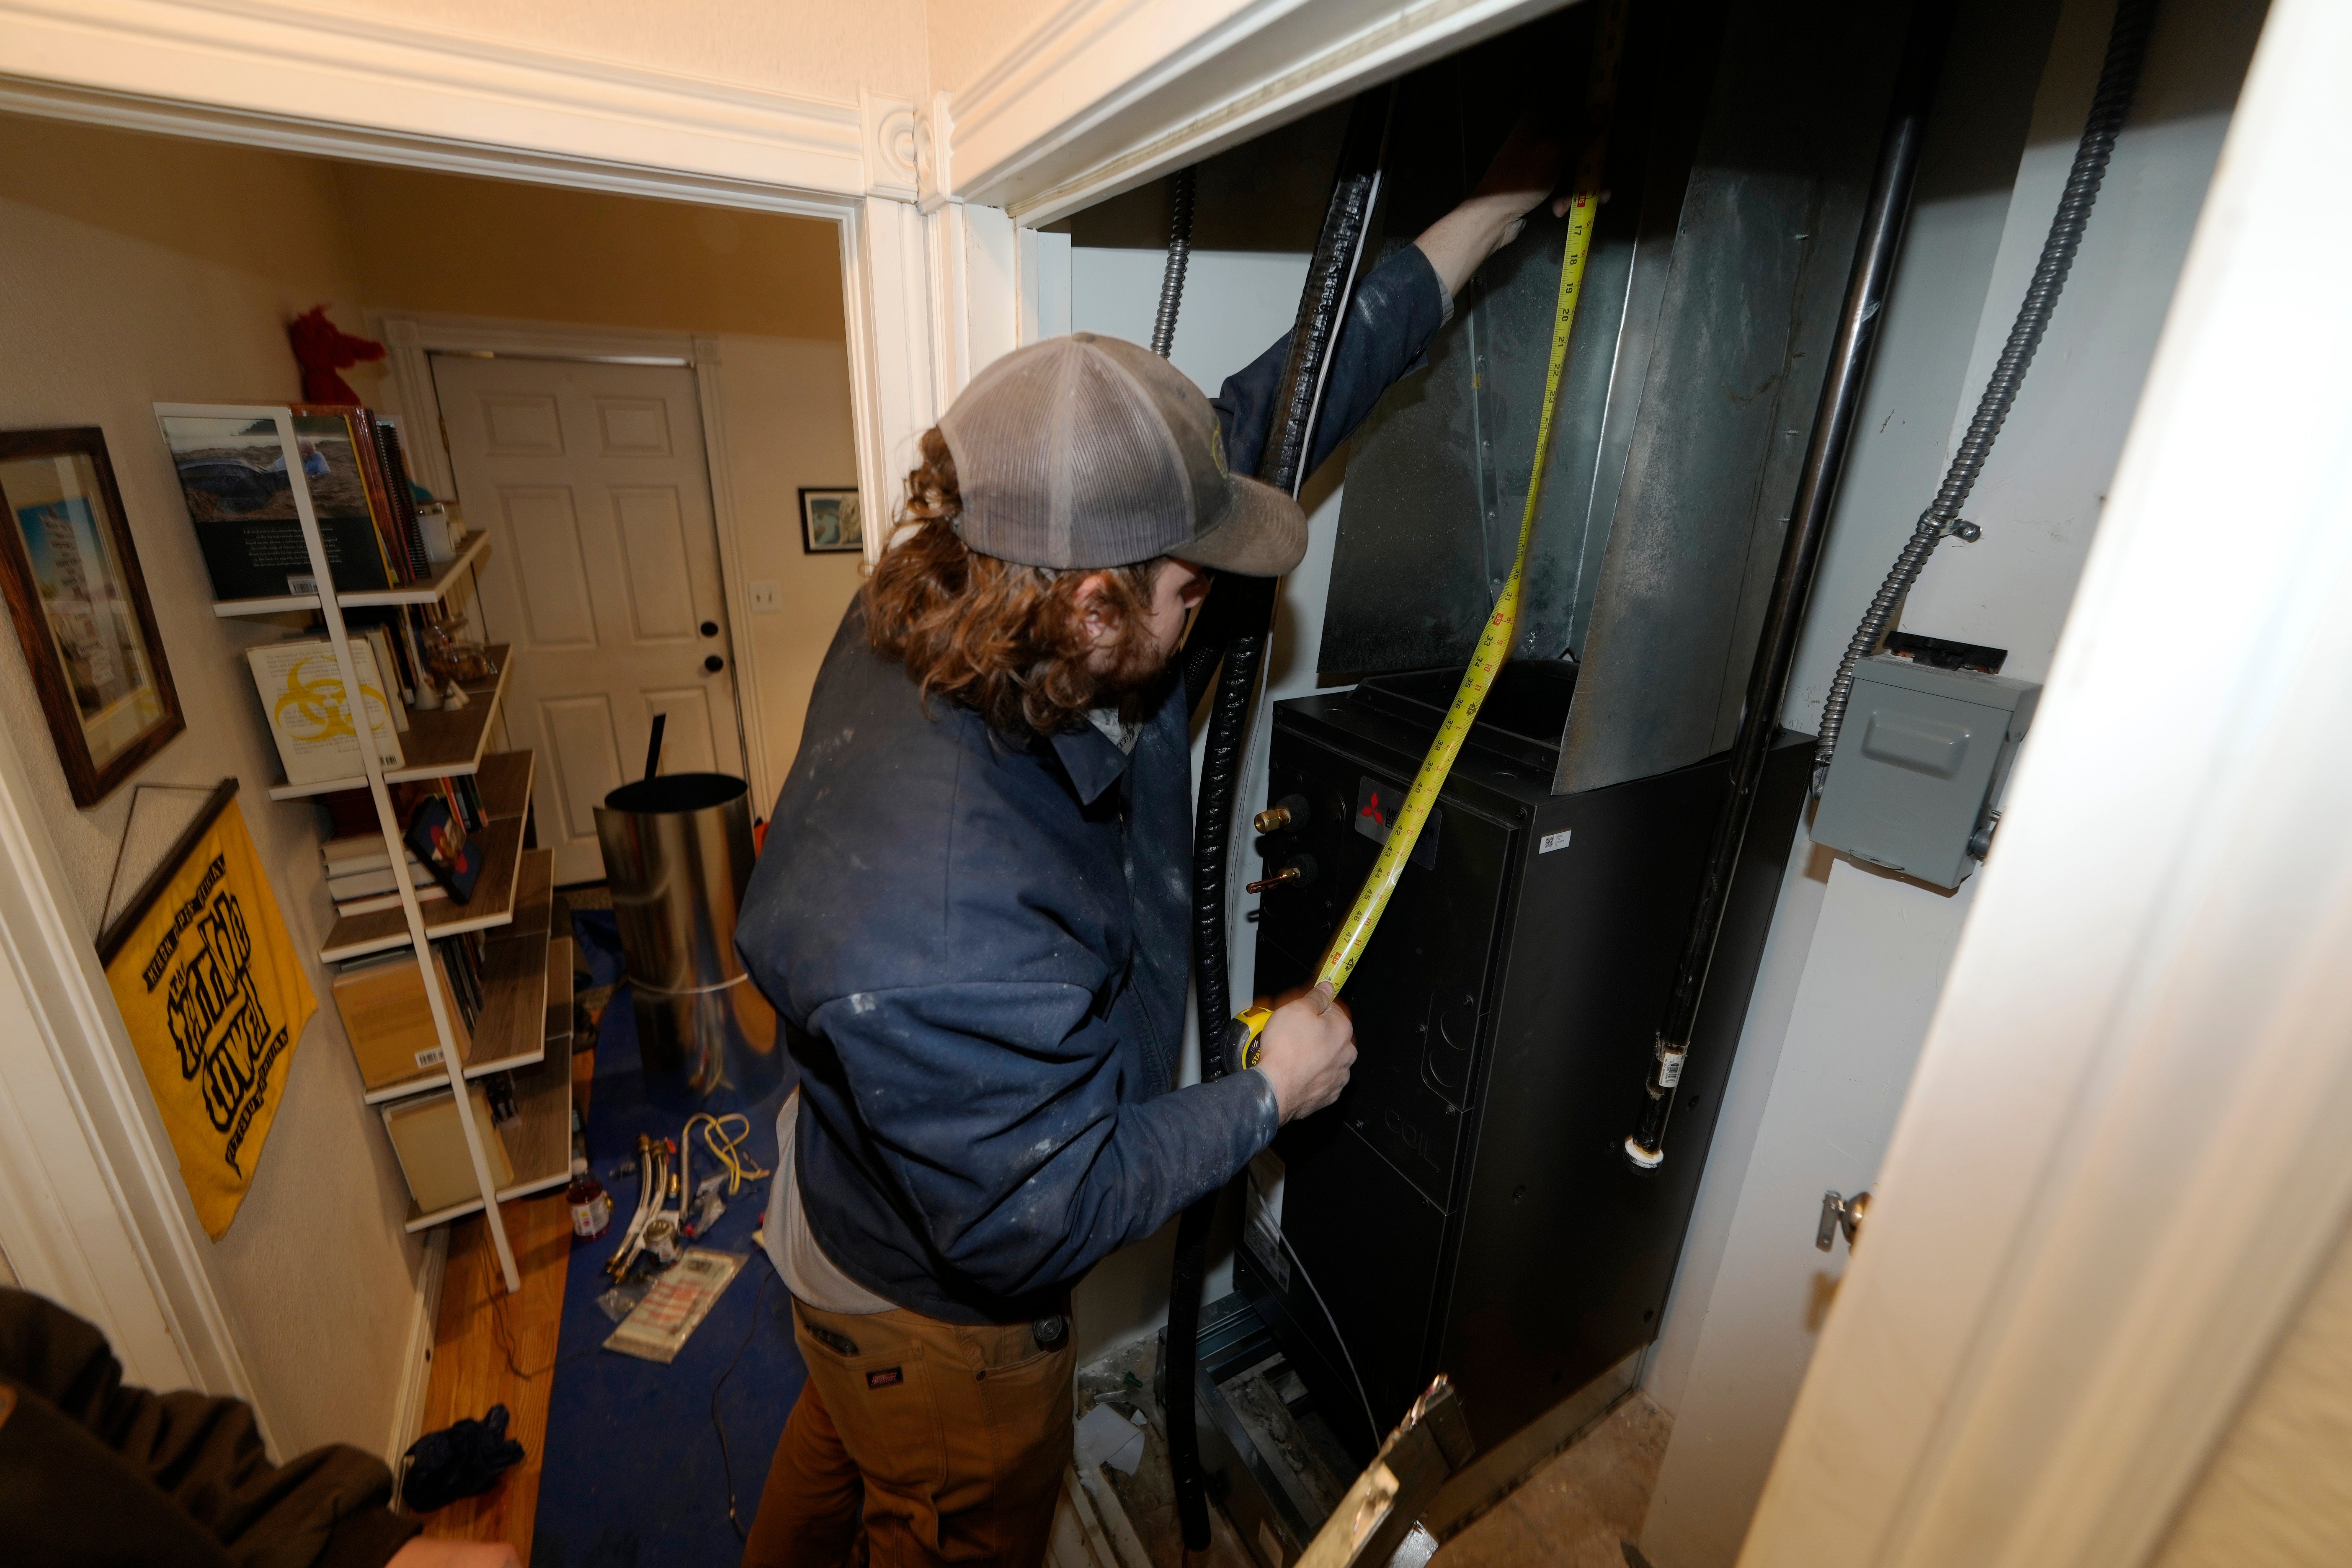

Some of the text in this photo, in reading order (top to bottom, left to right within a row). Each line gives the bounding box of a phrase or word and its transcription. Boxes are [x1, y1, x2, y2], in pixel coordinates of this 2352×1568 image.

[1579, 195, 1586, 204] 16
[1574, 224, 1582, 236] 17
[1570, 254, 1578, 265] 18
[1566, 282, 1573, 294] 19
[1561, 308, 1569, 322] 20
[1558, 336, 1565, 347] 21
[1553, 364, 1560, 377] 22
[1513, 568, 1520, 580] 30
[1505, 591, 1513, 601] 31
[1494, 615, 1502, 624] 32
[1484, 635, 1493, 647] 33
[1474, 656, 1483, 668] 34
[1484, 663, 1493, 672] 10
[1465, 677, 1473, 689] 35
[1455, 698, 1463, 709] 36
[1468, 704, 1475, 714] 3F
[1446, 719, 1453, 731] 37
[1435, 739, 1443, 751] 38
[1425, 761, 1433, 772] 39
[1415, 781, 1423, 793] 40
[1406, 803, 1413, 813] 41
[1395, 824, 1403, 836] 42
[1385, 846, 1393, 857] 43
[1375, 867, 1382, 879] 44
[1364, 888, 1372, 900] 45
[1354, 910, 1362, 922] 46
[1364, 917, 1372, 926] 10
[1343, 931, 1352, 944] 47
[1333, 954, 1341, 963] 48
[1385, 1109, 1440, 1172] COIL
